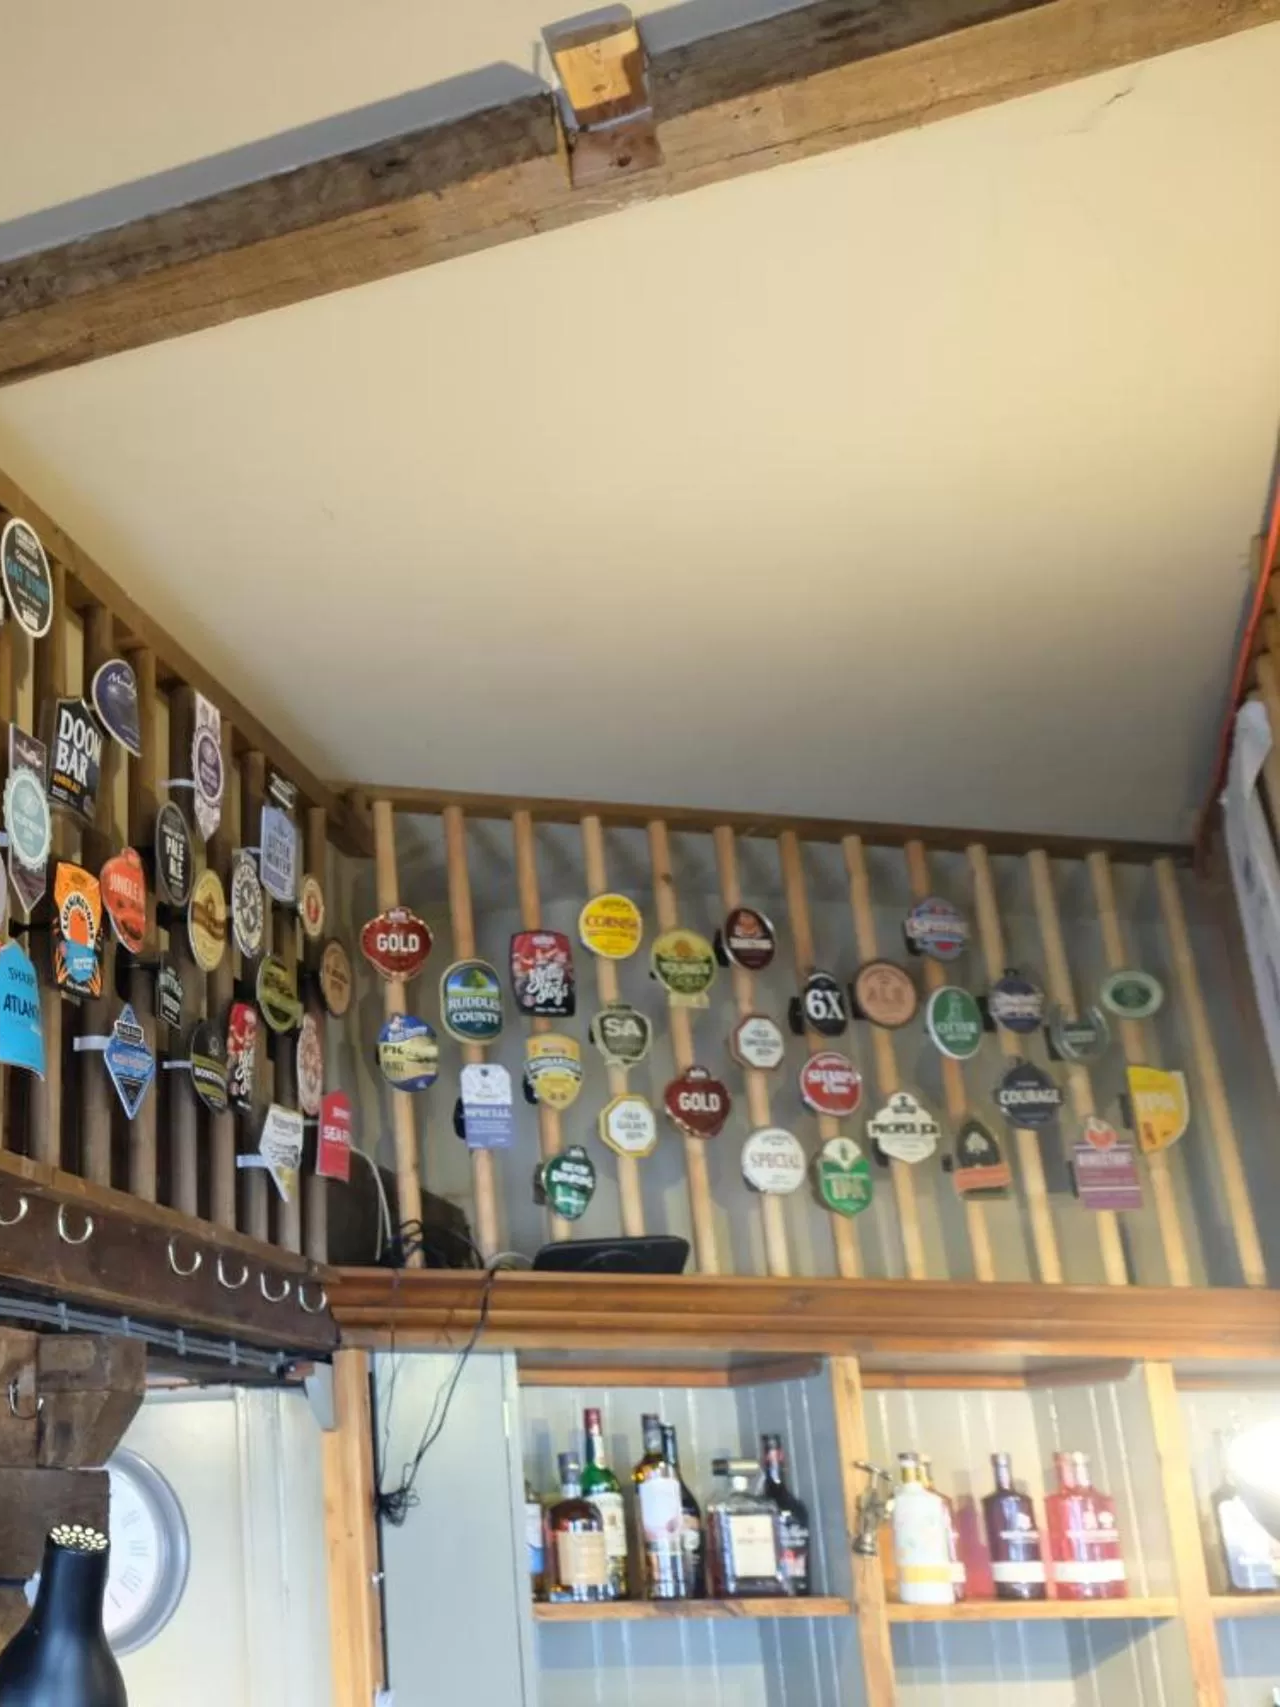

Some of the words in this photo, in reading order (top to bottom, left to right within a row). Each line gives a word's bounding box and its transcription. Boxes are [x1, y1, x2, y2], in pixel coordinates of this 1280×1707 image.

[56, 740, 87, 787] BAR
[376, 933, 420, 953] GOLD
[805, 989, 844, 1021] 6X
[451, 1011, 500, 1025] COUNTY
[603, 1017, 642, 1038] SA
[678, 1093, 721, 1111] GOLD
[1000, 1089, 1060, 1105] COURAGE
